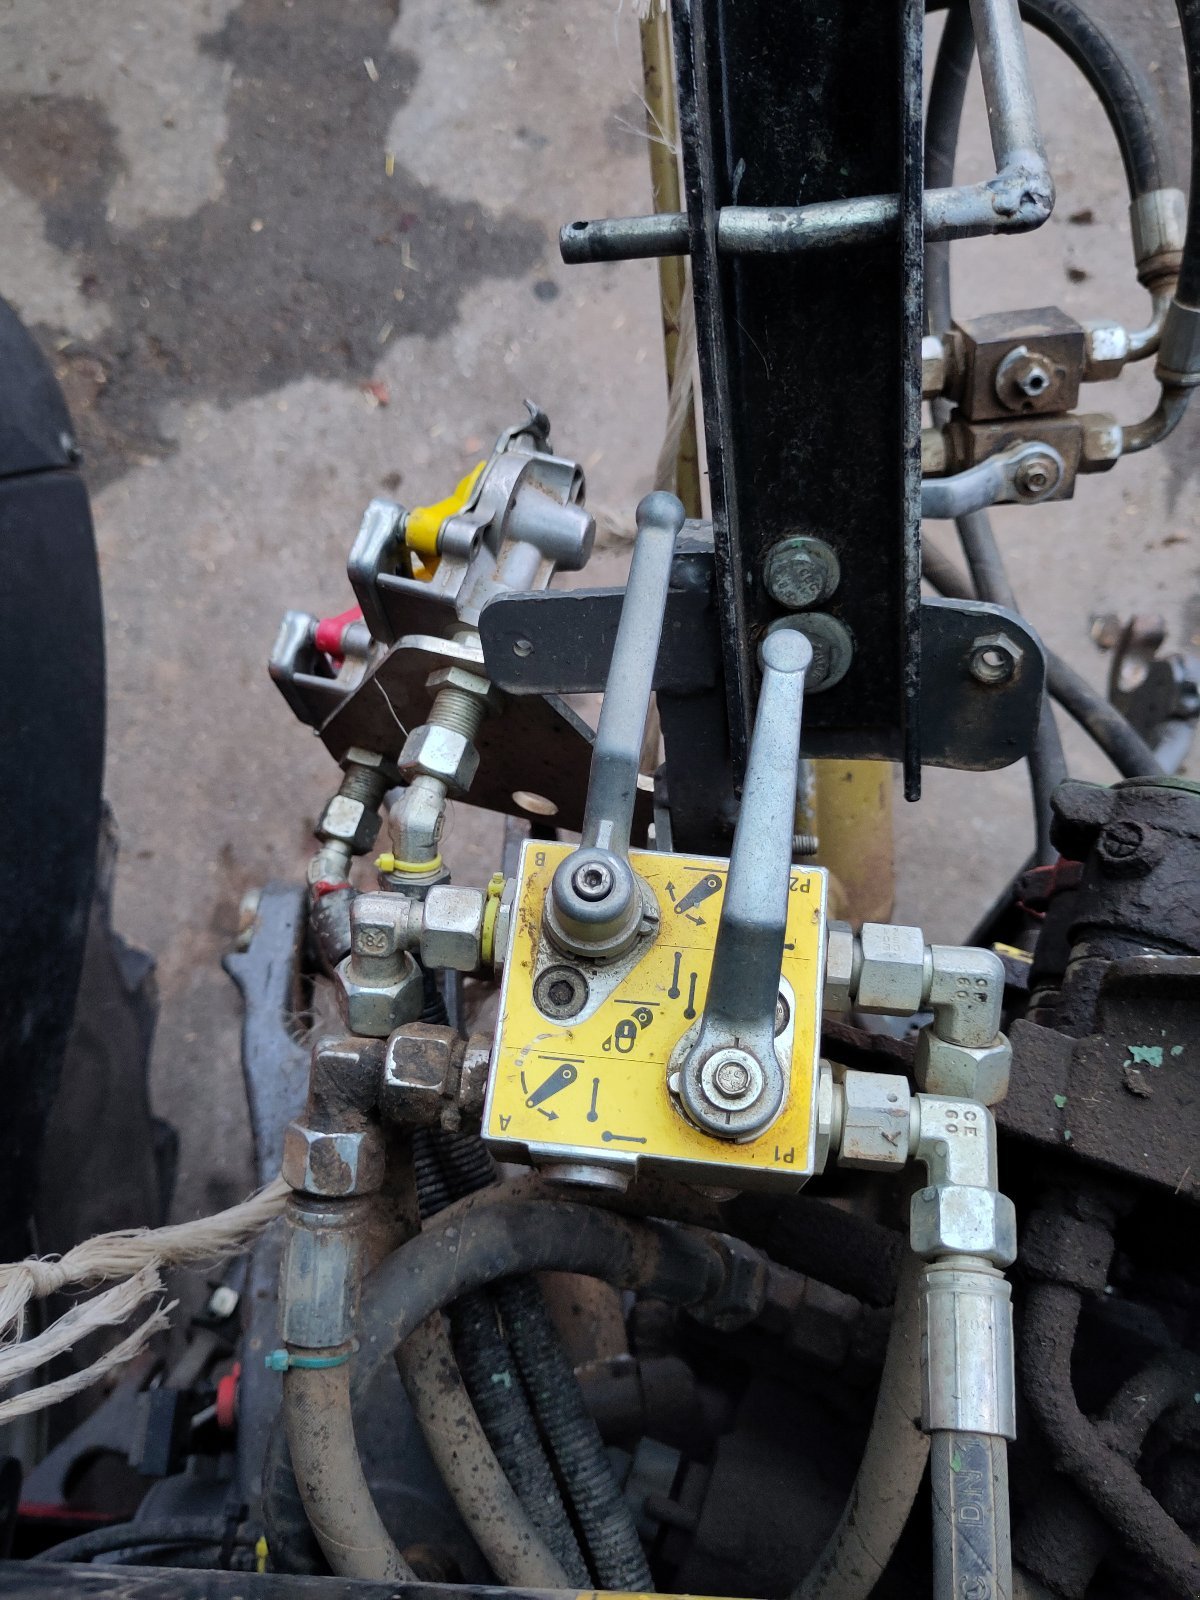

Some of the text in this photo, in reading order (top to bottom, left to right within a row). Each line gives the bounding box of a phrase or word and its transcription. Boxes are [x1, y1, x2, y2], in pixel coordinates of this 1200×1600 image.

[535, 851, 546, 867] B
[790, 876, 811, 894] P2
[498, 1114, 513, 1132] A
[944, 1108, 960, 1136] 60
[963, 1109, 979, 1138] CE
[774, 1145, 796, 1165] P1
[956, 1469, 986, 1527] DN
